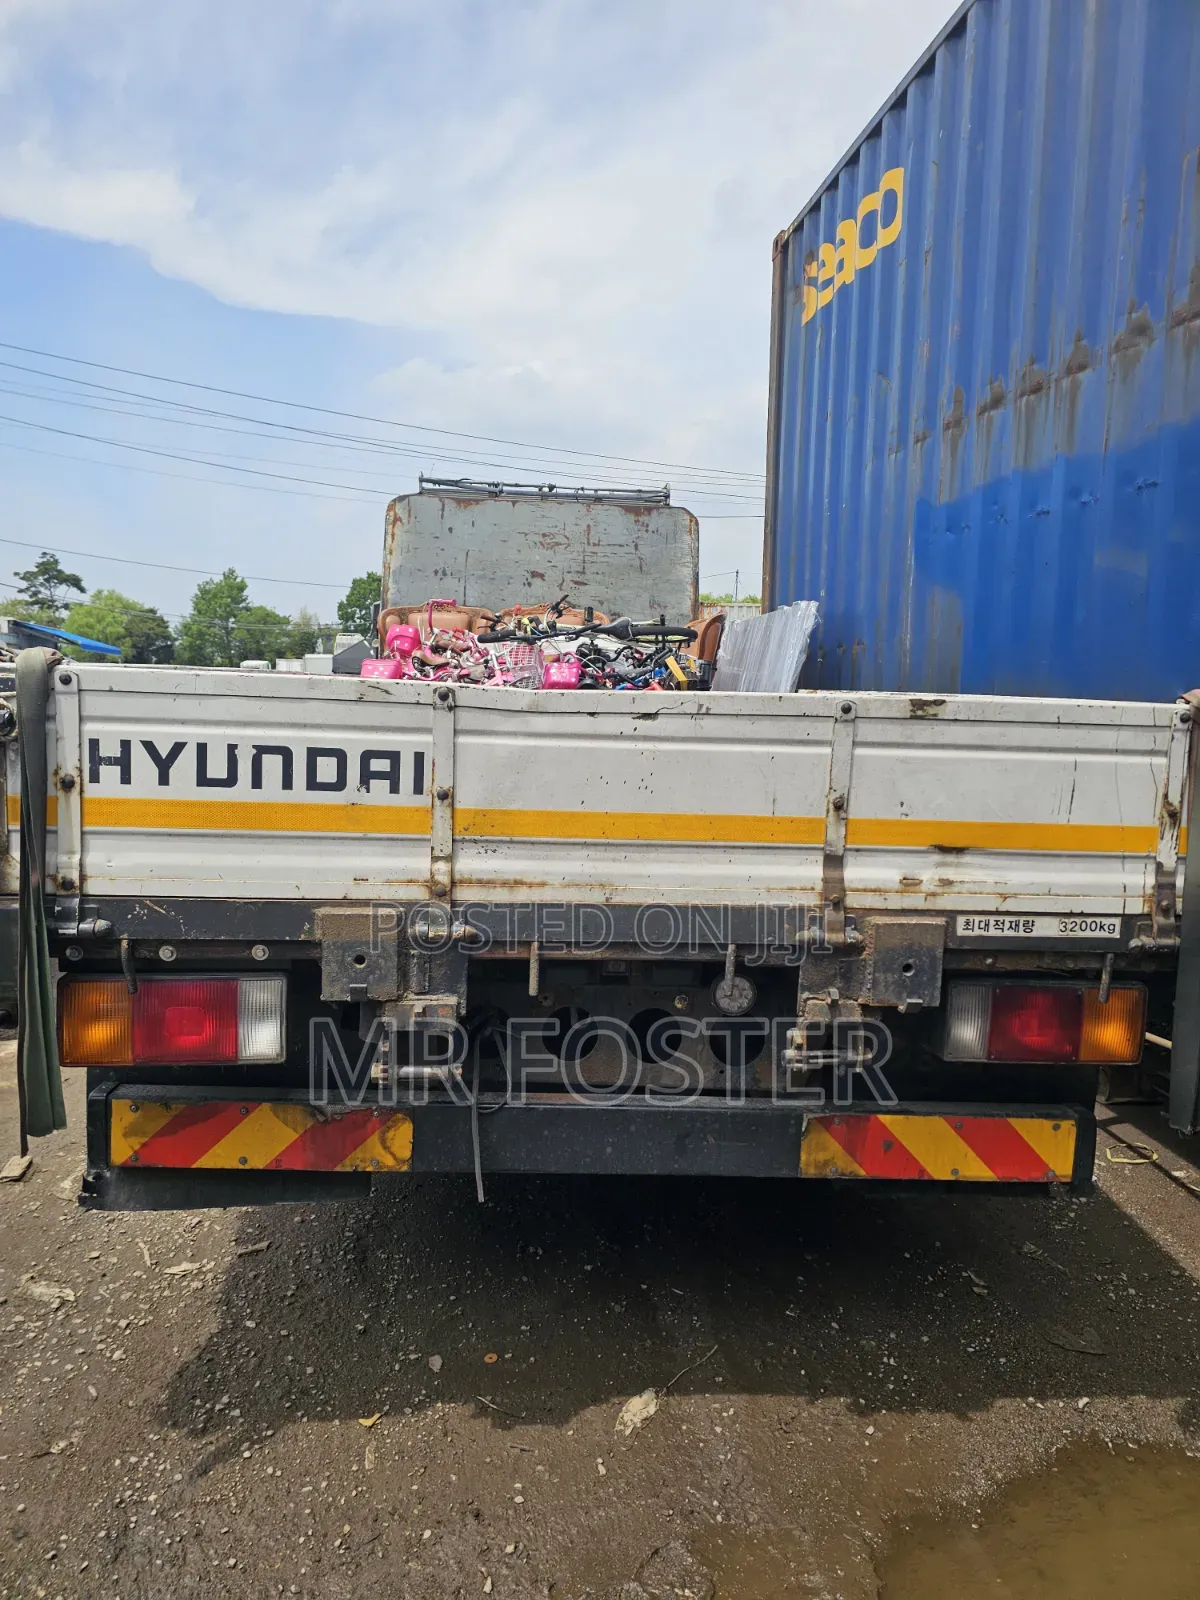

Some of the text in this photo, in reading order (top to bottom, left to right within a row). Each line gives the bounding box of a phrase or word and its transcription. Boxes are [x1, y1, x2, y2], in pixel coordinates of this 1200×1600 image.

[801, 167, 904, 326] seaco
[88, 738, 425, 795] HYUNDAI
[962, 918, 1117, 935] 최대적재량 3200kg
